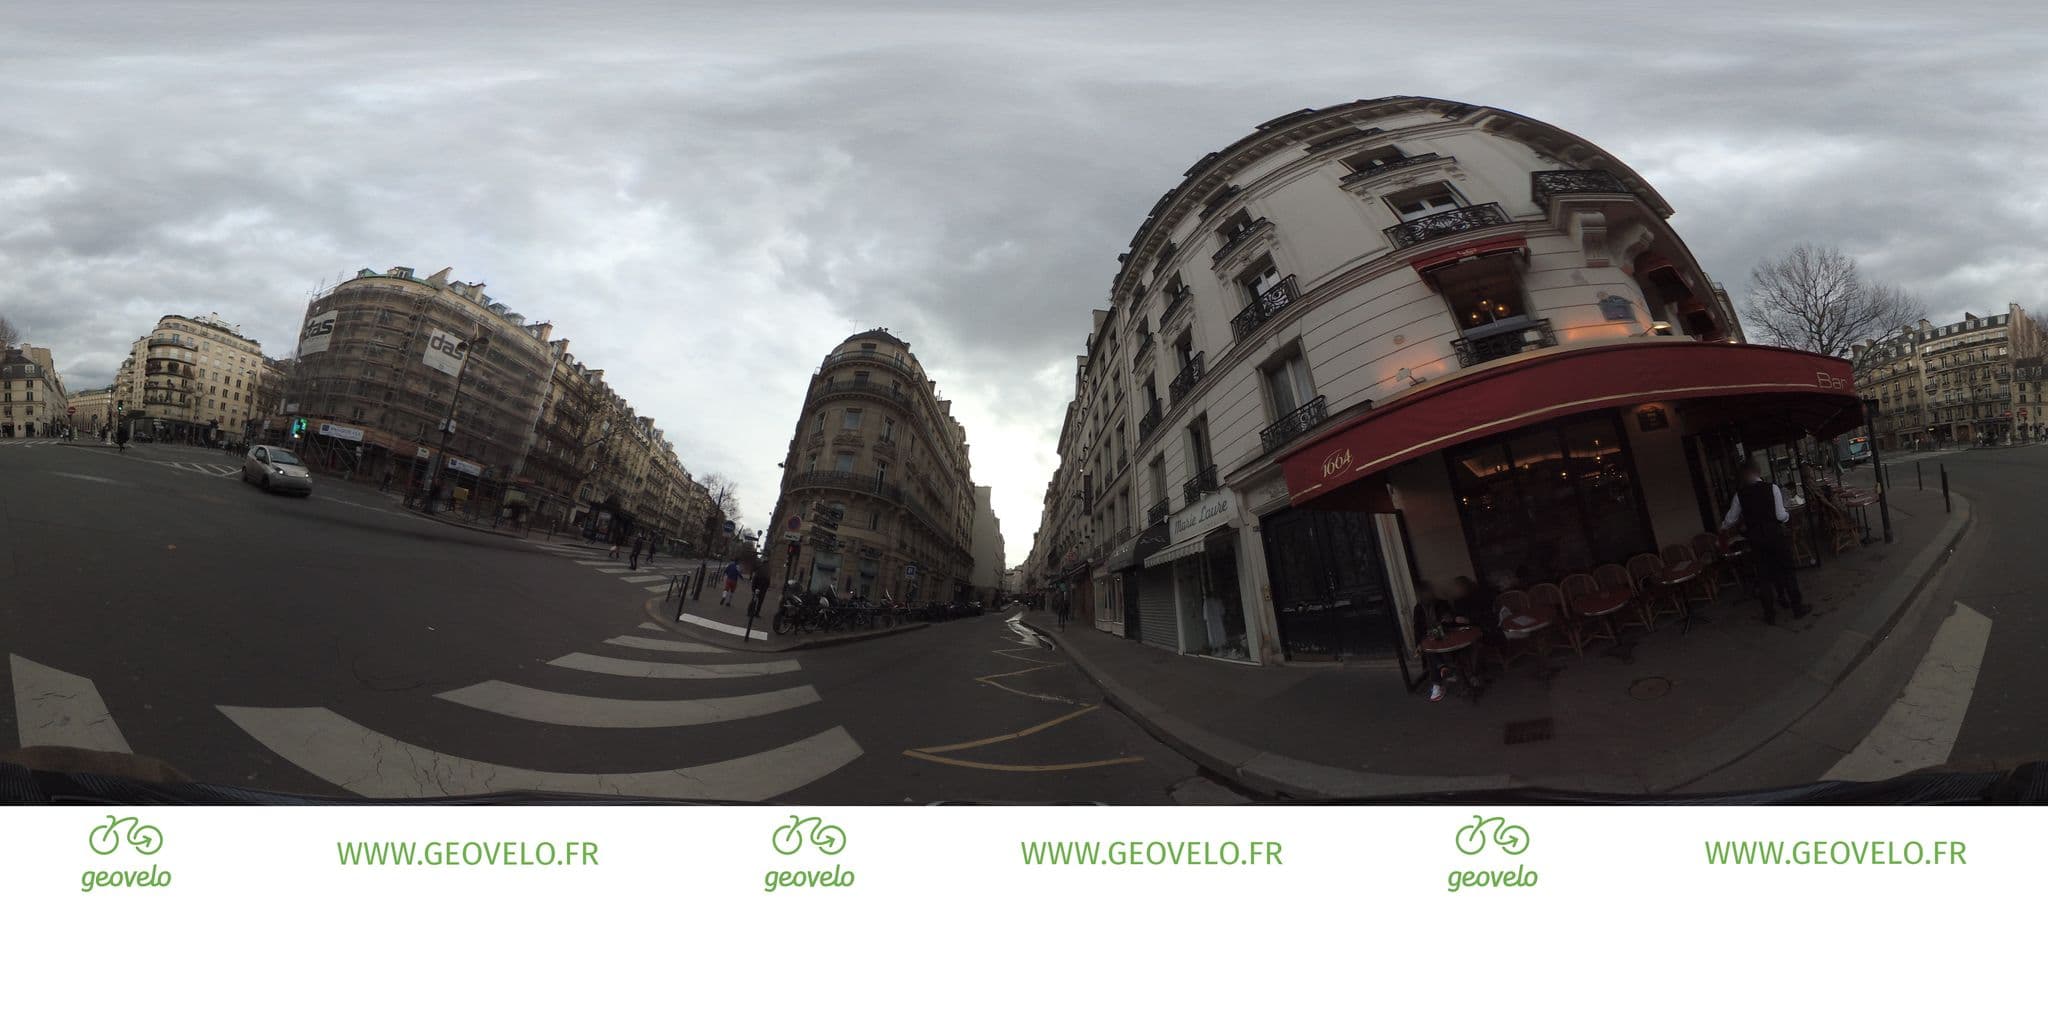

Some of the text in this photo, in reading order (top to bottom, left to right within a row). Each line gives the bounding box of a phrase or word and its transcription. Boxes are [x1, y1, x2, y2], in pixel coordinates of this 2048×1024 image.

[1816, 371, 1847, 392] Bar
[1322, 448, 1352, 478] 1664
[1174, 500, 1228, 535] Marie Laure
